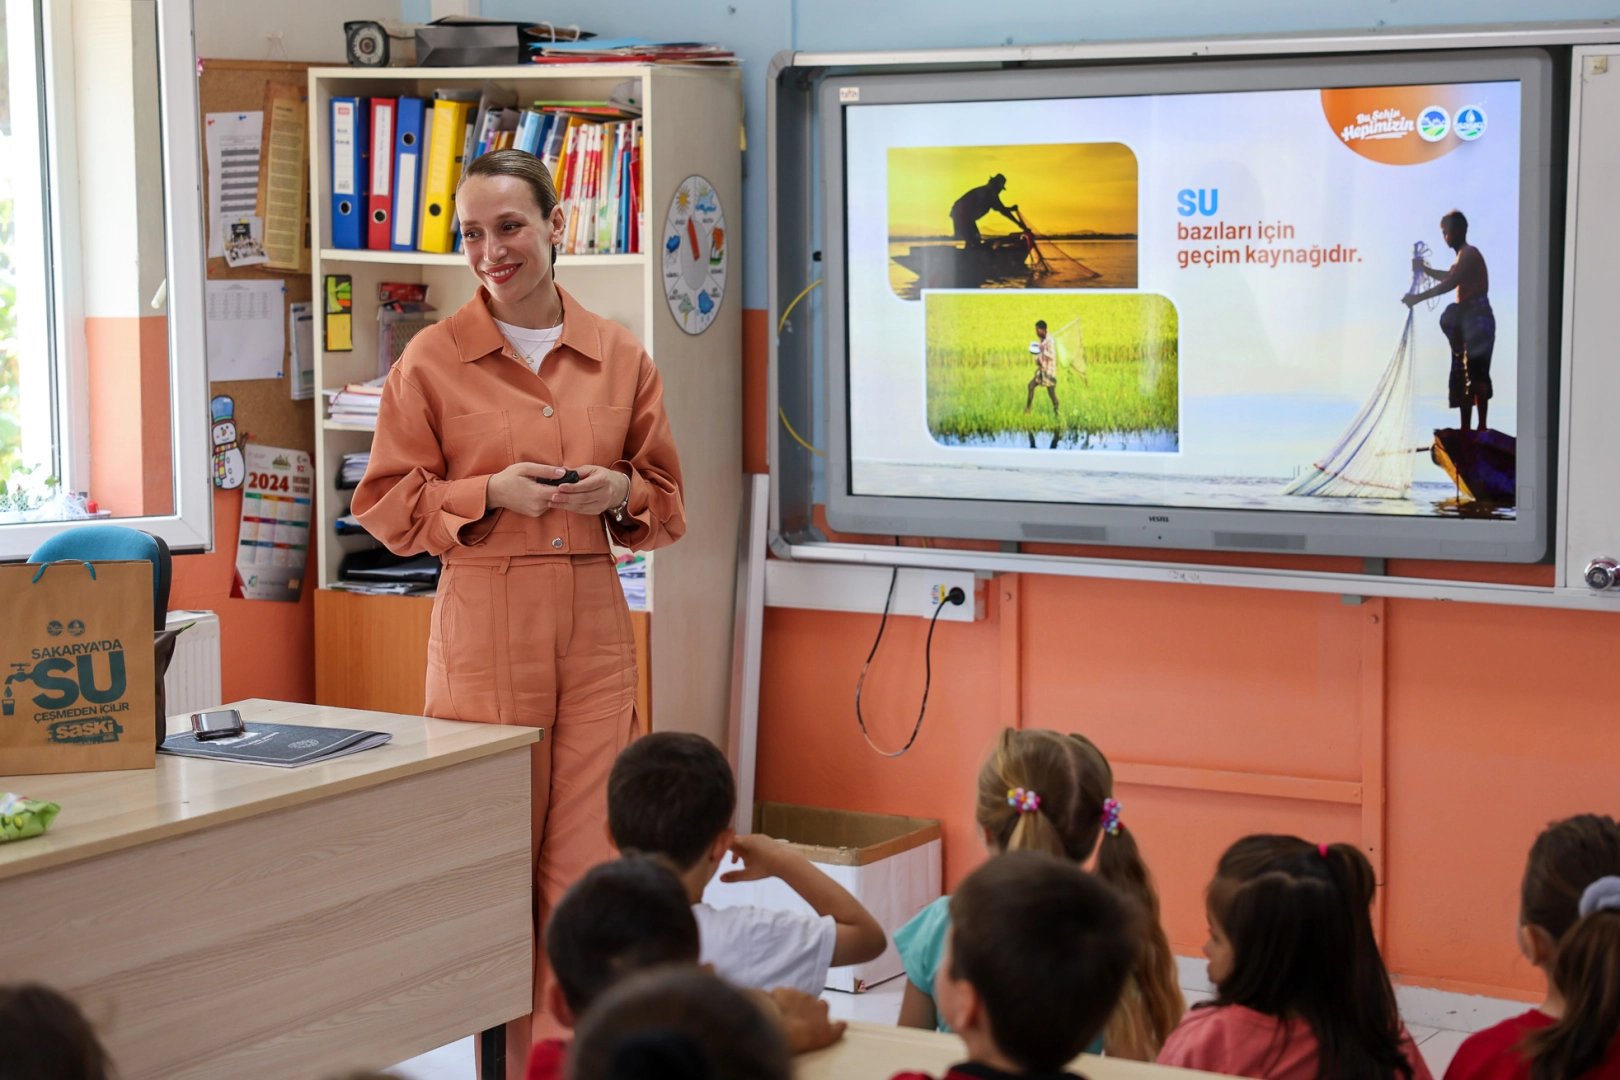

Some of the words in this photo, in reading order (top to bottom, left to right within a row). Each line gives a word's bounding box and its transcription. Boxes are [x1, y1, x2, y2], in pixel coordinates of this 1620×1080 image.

[1340, 116, 1415, 142] Hepimizin
[1356, 112, 1371, 124] Bu
[1177, 188, 1219, 217] SU
[1177, 221, 1252, 241] bazıları
[1257, 220, 1295, 244] için
[1177, 245, 1241, 269] geçim
[1245, 243, 1363, 269] kaynağıdır.
[247, 471, 290, 493] 2024
[1148, 515, 1170, 523] VESTEL
[31, 638, 123, 660] SAKARYA'DA
[31, 650, 127, 710] SU
[33, 706, 98, 723] ÇEŞMEDEN
